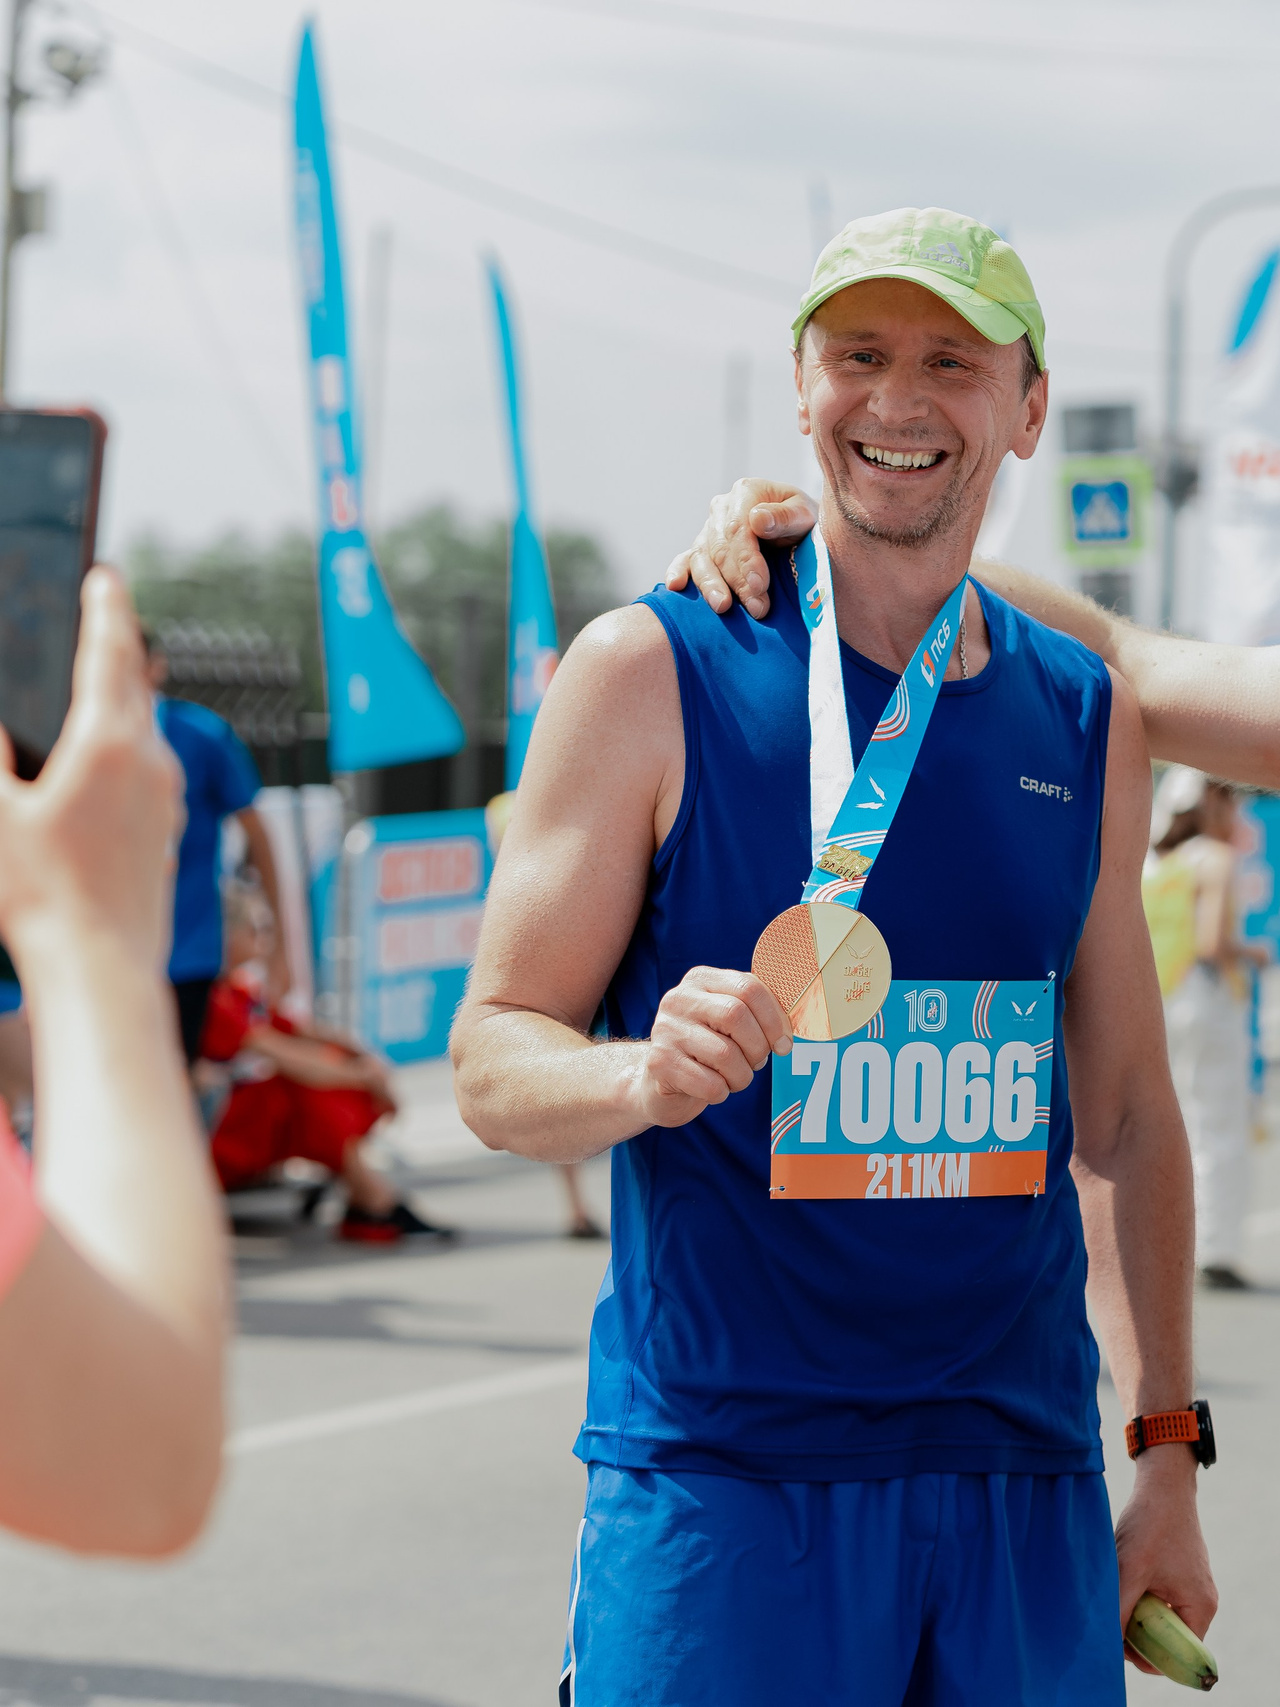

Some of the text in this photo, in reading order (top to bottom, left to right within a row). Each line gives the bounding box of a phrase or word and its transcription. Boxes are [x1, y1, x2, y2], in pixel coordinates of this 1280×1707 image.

[919, 251, 970, 271] adidas
[930, 617, 951, 663] ПСБ
[1020, 775, 1062, 799] CRAFT
[903, 988, 948, 1033] 10
[791, 1040, 1037, 1144] 70066
